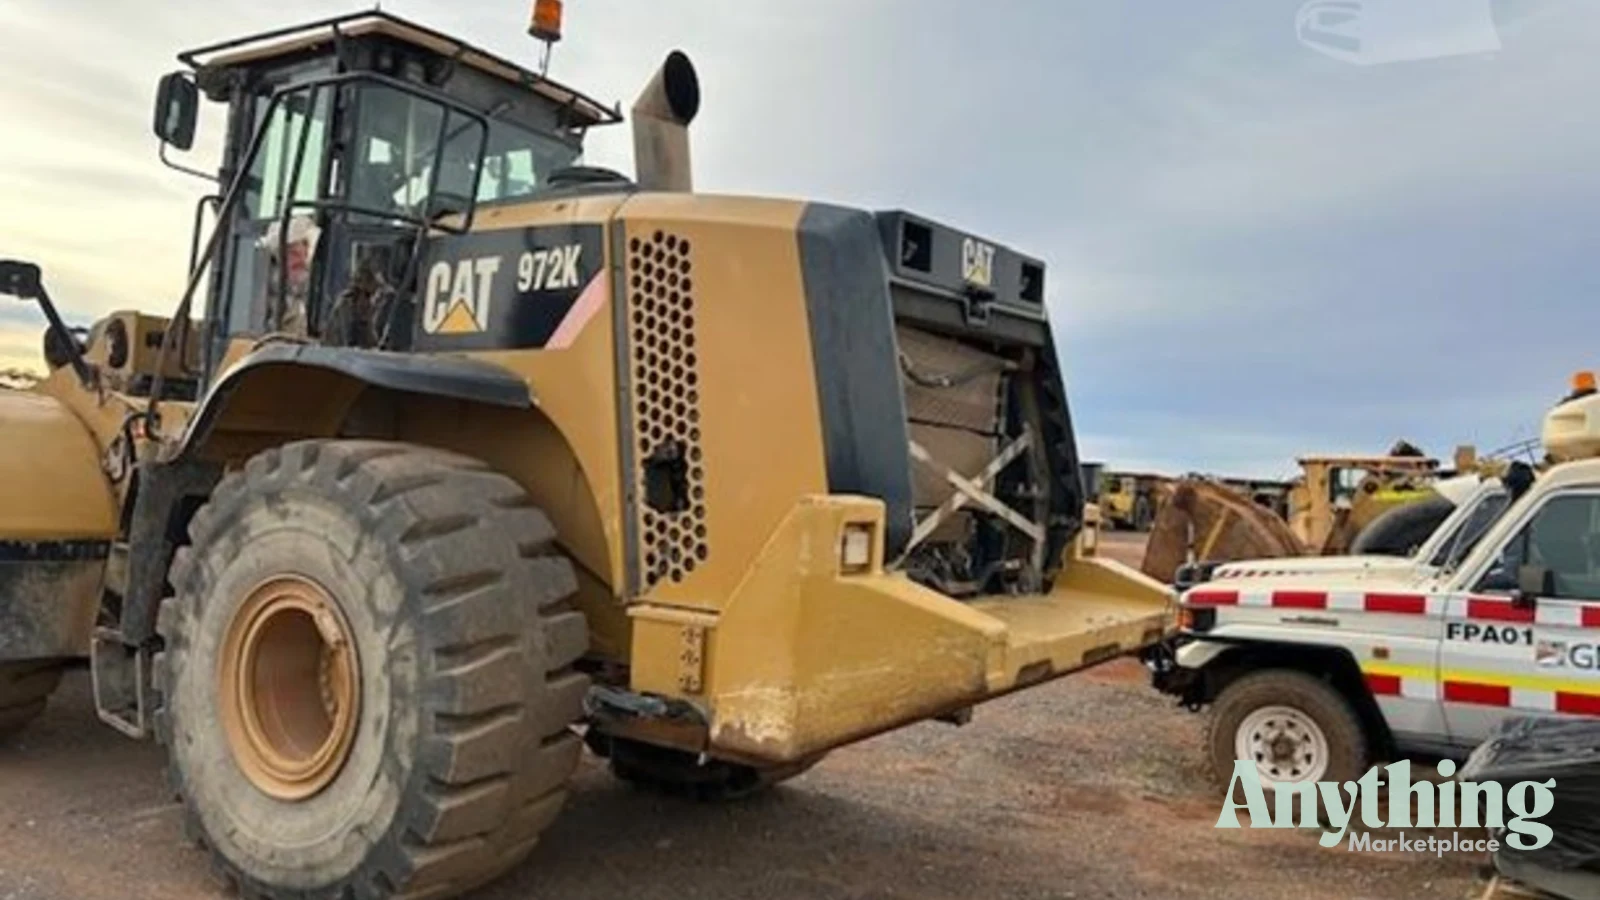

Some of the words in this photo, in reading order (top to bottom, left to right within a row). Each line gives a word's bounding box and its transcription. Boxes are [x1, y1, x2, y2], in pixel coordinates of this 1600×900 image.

[517, 244, 582, 292] 972K
[962, 237, 996, 287] CAT
[423, 255, 502, 335] CAT
[1447, 622, 1533, 645] FPA01
